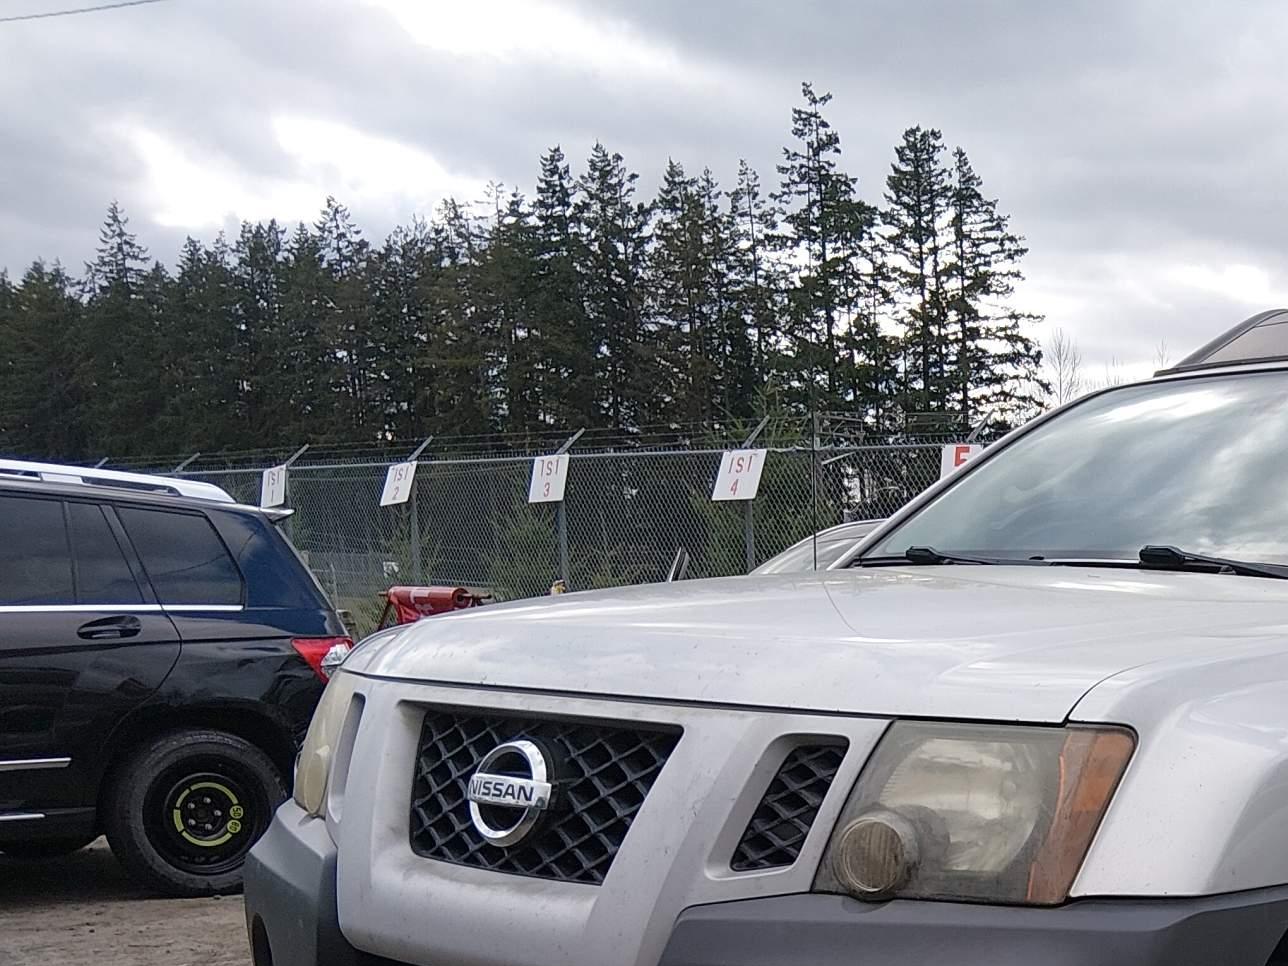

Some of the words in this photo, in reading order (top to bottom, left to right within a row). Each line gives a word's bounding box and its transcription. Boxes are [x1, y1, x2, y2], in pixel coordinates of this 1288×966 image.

[543, 481, 551, 498] 3
[729, 478, 739, 497] 4
[470, 779, 534, 802] NISSAN
